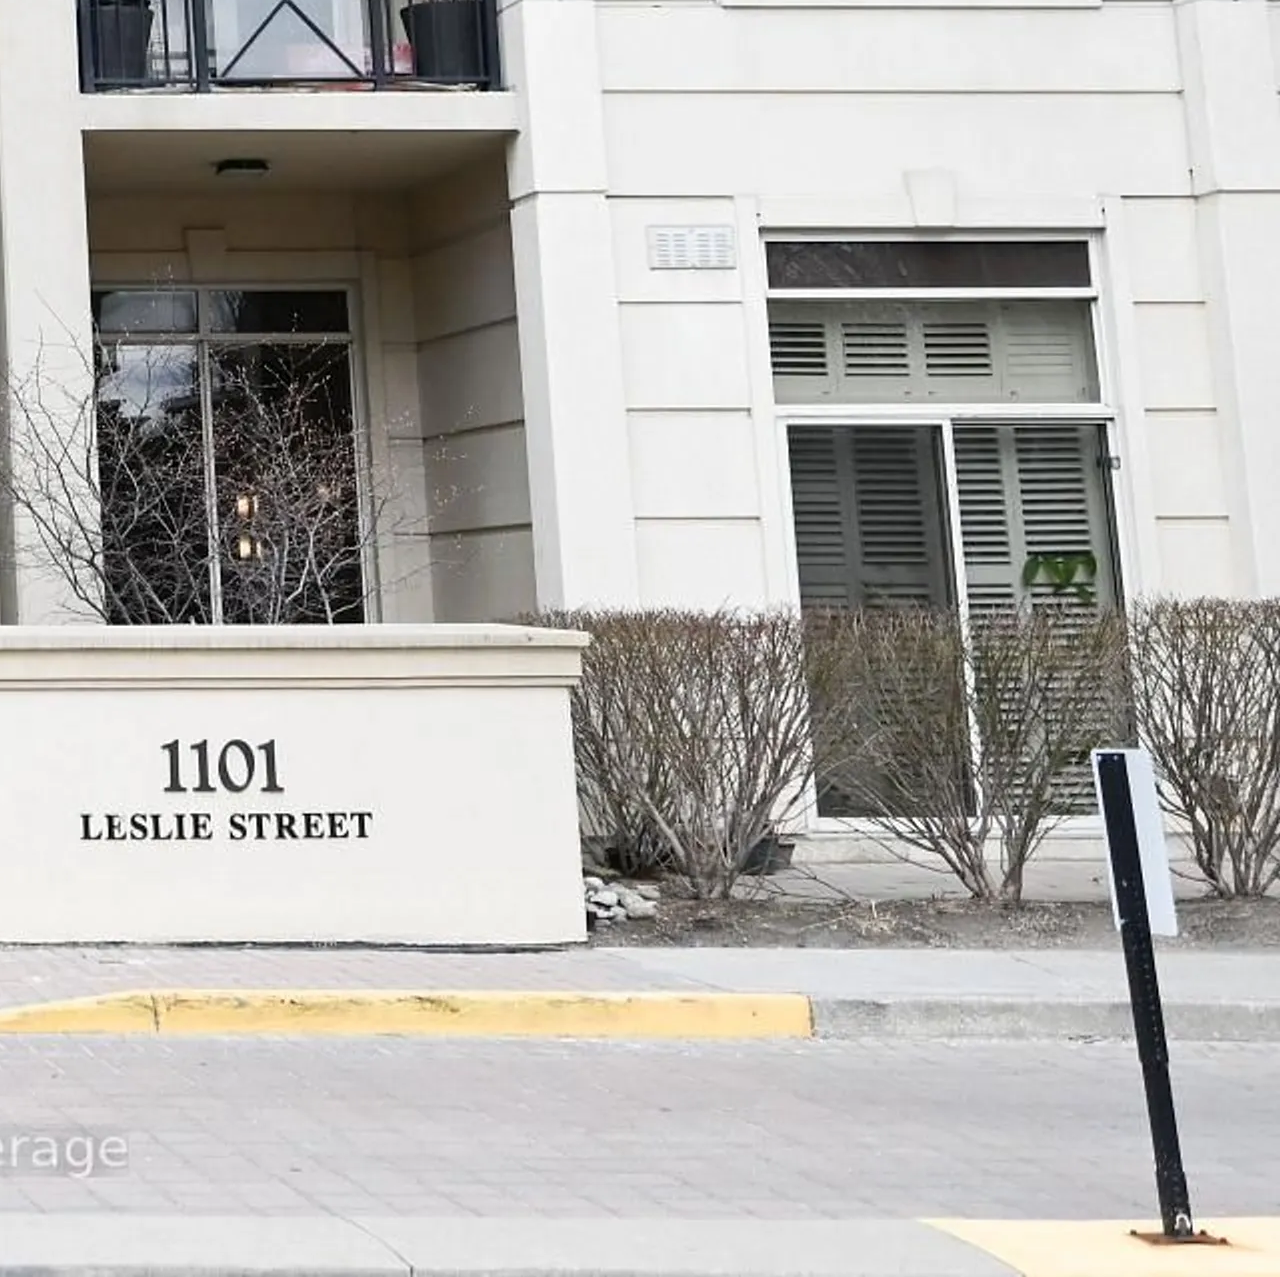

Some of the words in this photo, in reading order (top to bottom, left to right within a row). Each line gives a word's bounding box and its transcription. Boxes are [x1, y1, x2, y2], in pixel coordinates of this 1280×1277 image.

[160, 739, 286, 793] 1101
[80, 812, 214, 840] LESLIE
[228, 811, 373, 840] STREET
